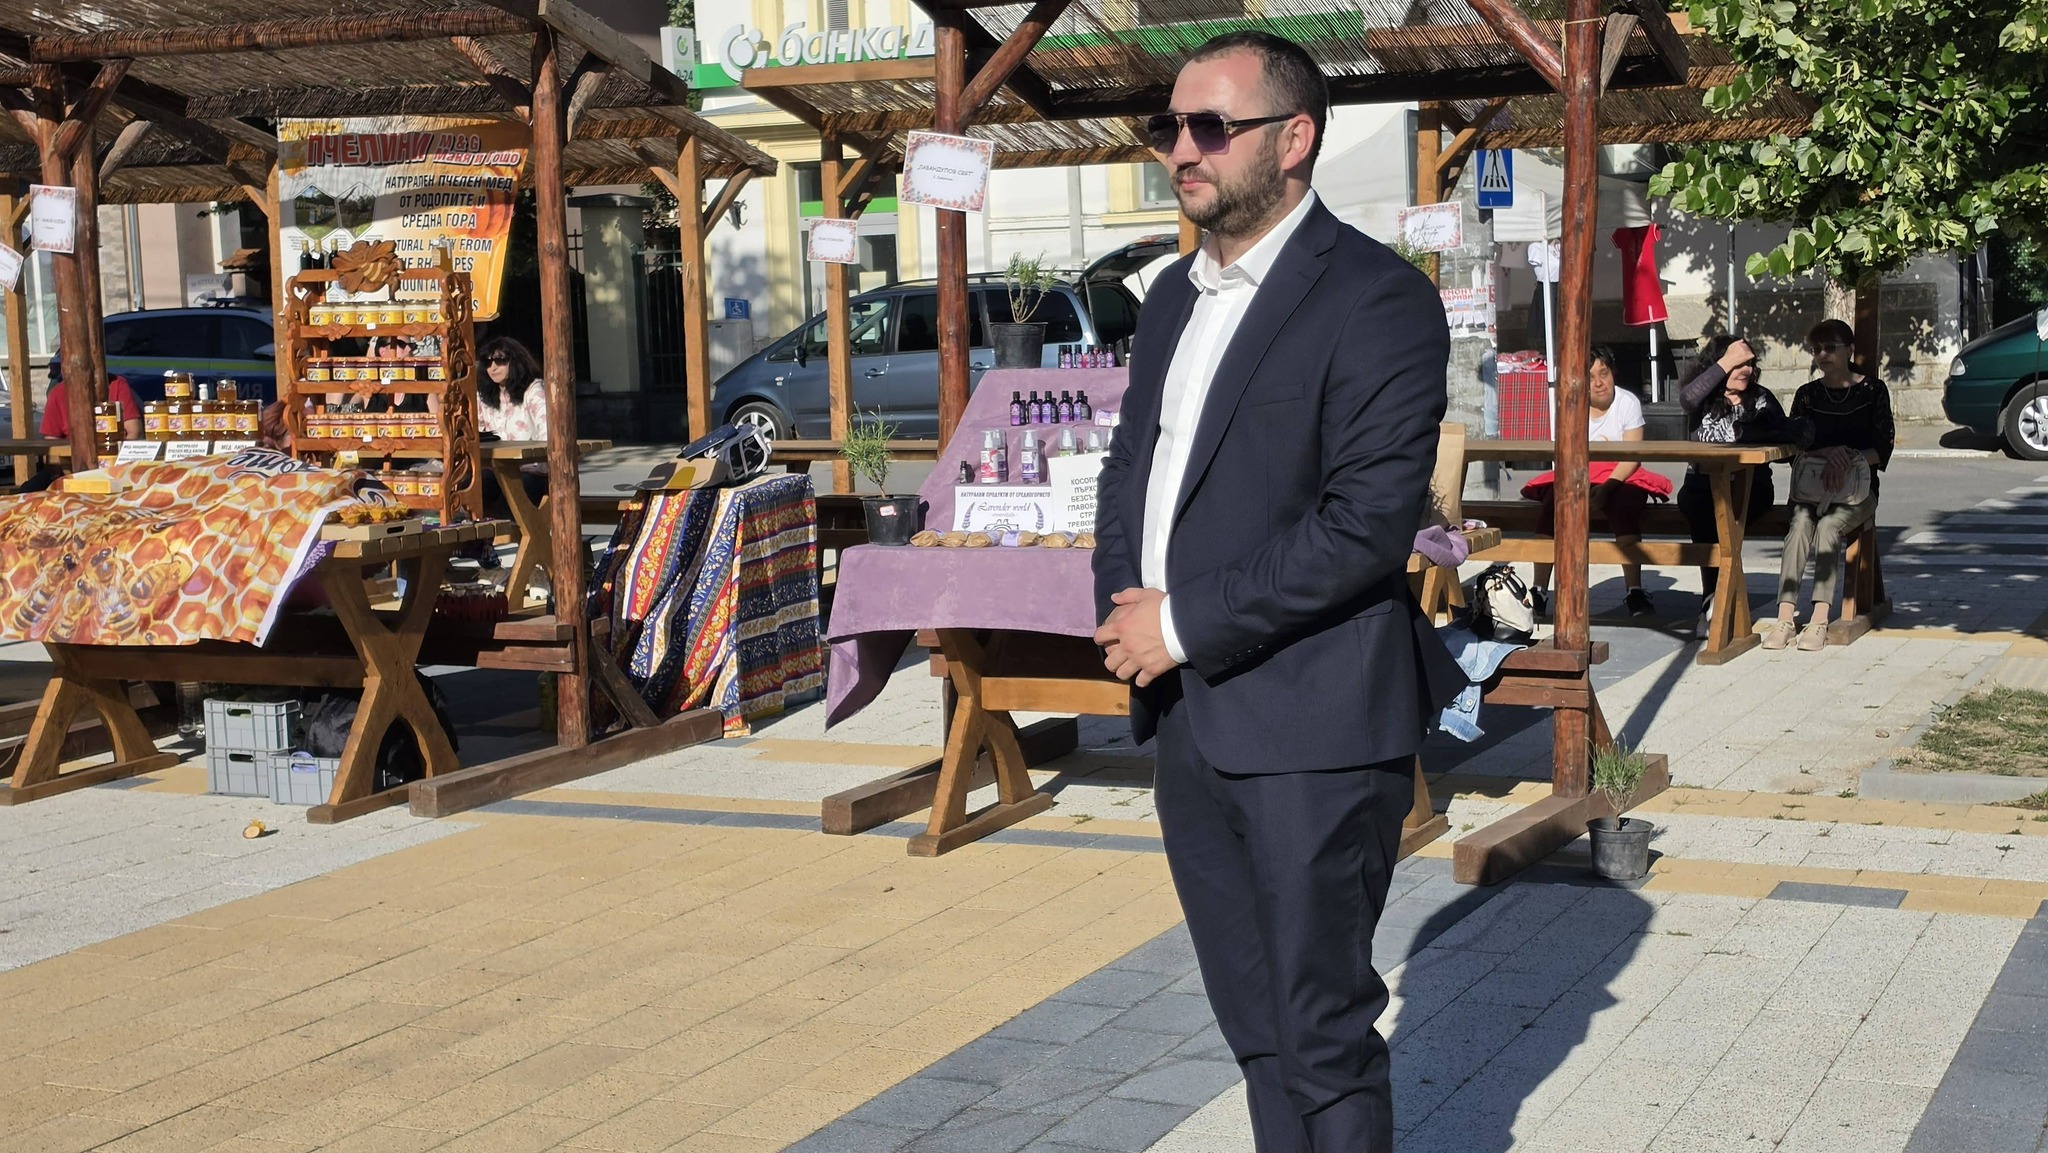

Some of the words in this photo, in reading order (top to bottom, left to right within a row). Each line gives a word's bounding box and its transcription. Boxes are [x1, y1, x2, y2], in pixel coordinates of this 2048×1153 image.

[778, 21, 904, 67] банка
[486, 150, 521, 166] Гошо
[384, 174, 436, 189] НАТУРАЛЕН
[437, 174, 482, 189] ПЧЕЛЕН
[485, 176, 514, 192] МЕД
[414, 193, 474, 209] РОДОПИТЕ
[401, 213, 442, 230] СРЕДНА
[445, 213, 476, 229] ГОРА
[393, 238, 424, 252] TURAL
[459, 238, 493, 253] FROM
[1074, 485, 1097, 494] ПЪРХО
